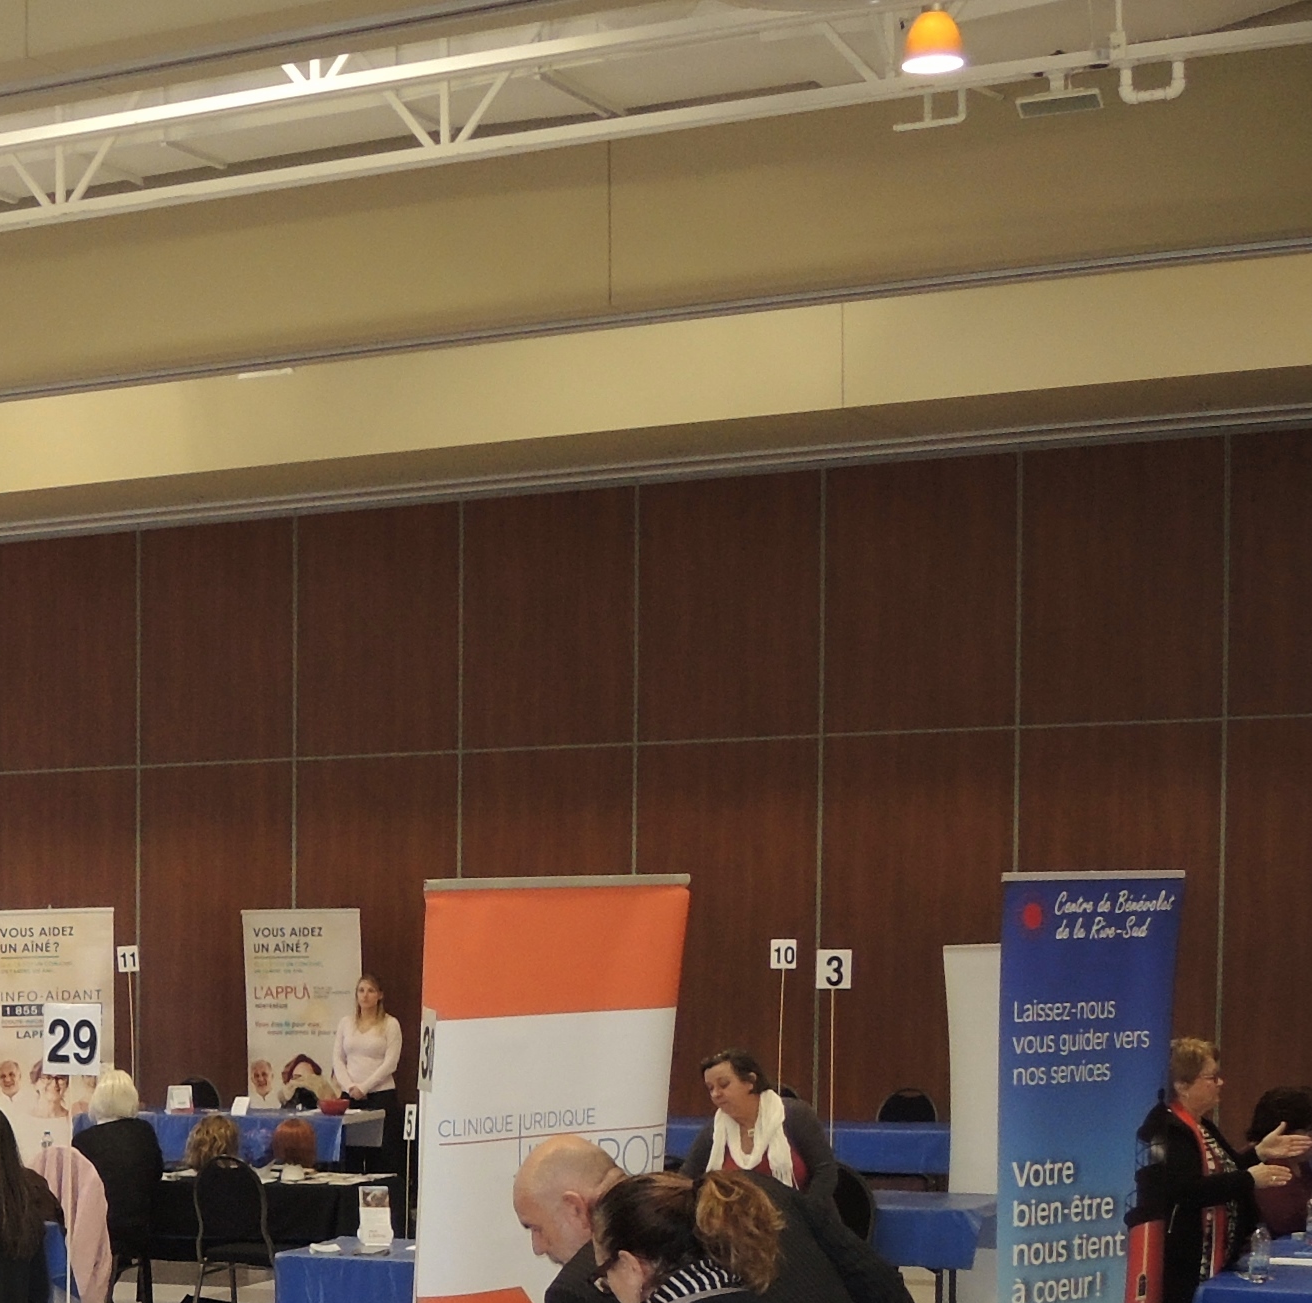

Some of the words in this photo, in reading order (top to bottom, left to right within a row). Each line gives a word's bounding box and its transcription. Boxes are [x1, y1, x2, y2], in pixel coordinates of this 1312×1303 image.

[1054, 890, 1094, 916] Centre
[1097, 892, 1111, 914] de
[1115, 889, 1175, 915] Bénévolat
[0, 927, 34, 938] VOUS
[39, 925, 74, 937] AIDEZ
[253, 927, 286, 938] VOUS
[290, 926, 323, 937] AIDEZ
[1056, 918, 1070, 940] de
[1073, 917, 1086, 939] la
[1090, 915, 1152, 940] Rive-Sud
[0, 942, 18, 954] UN
[120, 952, 136, 968] 11
[253, 943, 269, 954] UN
[774, 946, 795, 964] 10
[825, 955, 844, 986] 3
[5, 1006, 11, 1015] 1
[1013, 1000, 1116, 1023] Laissez-nous
[47, 1018, 98, 1066] 29
[1013, 1033, 1055, 1054] vous
[1059, 1028, 1110, 1056] guider
[1114, 1029, 1150, 1049] vers
[1013, 1066, 1047, 1086] nos
[1051, 1059, 1111, 1084] services
[406, 1110, 413, 1138] 5
[437, 1114, 514, 1139] CLINIQUE
[1012, 1158, 1075, 1188] Votre
[1012, 1194, 1114, 1228] bien-être
[1012, 1240, 1067, 1267] nous
[1072, 1231, 1126, 1261] tient
